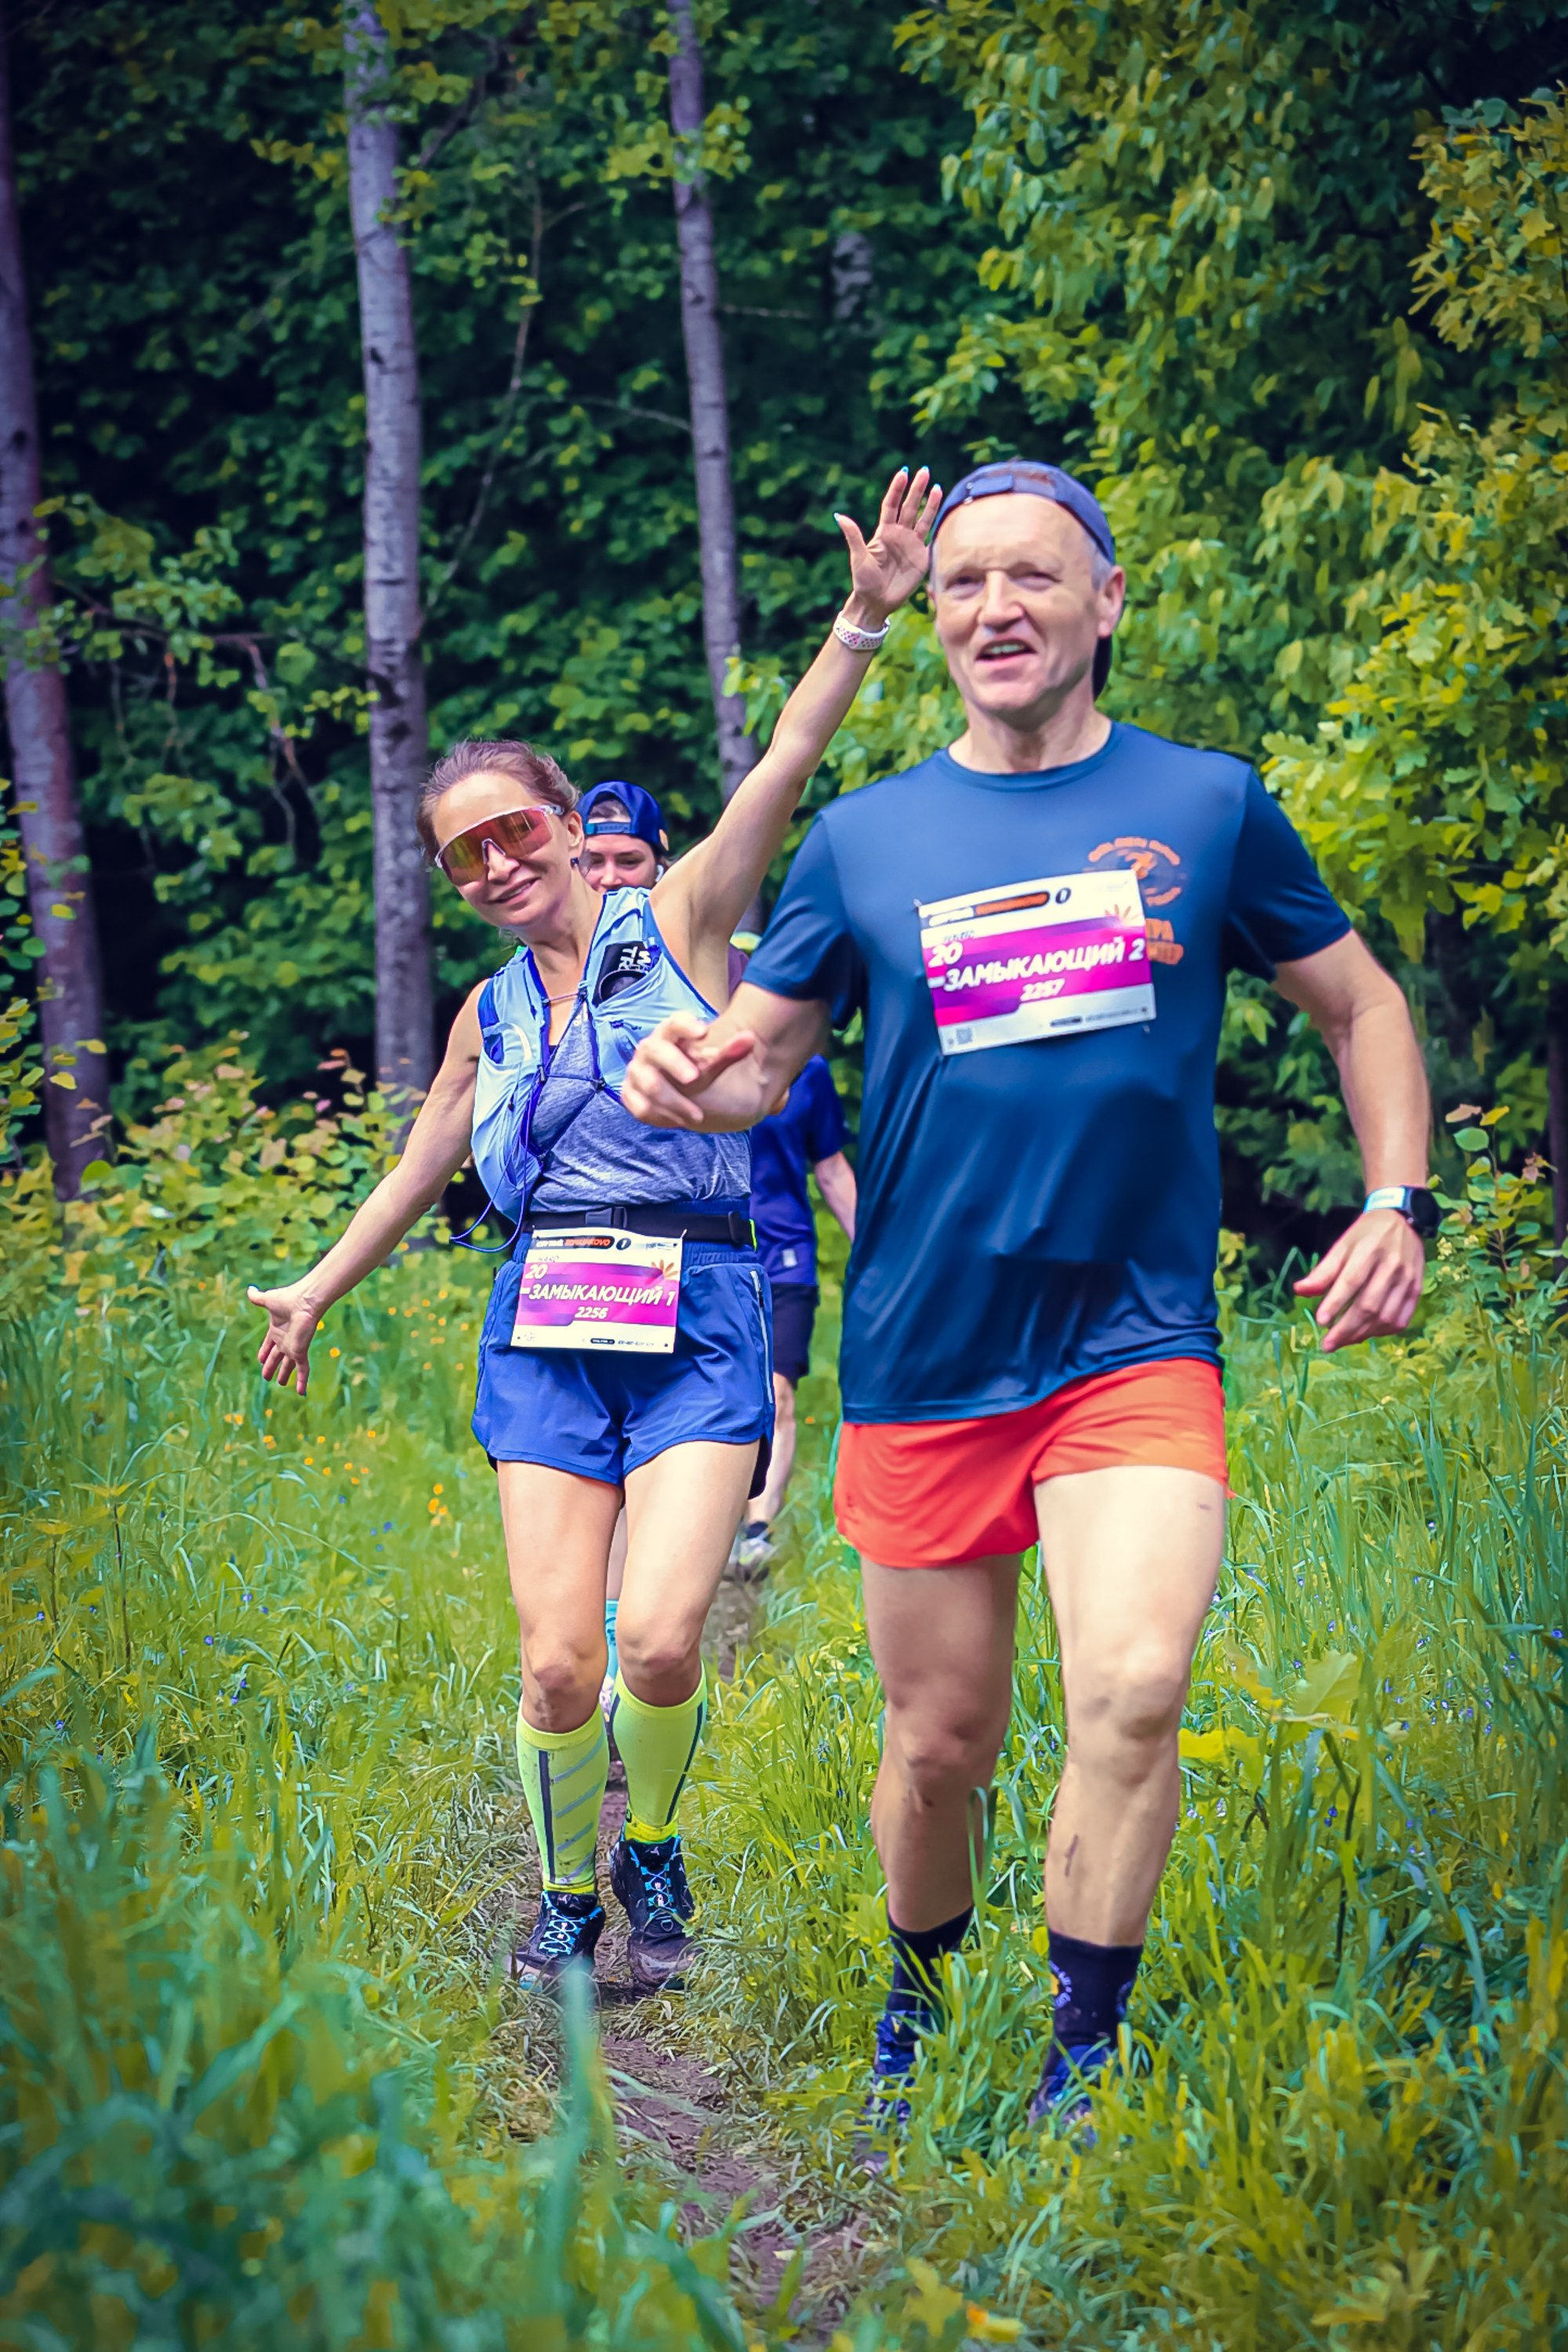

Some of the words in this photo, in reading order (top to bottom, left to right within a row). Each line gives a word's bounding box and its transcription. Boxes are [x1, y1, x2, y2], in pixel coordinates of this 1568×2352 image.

[927, 941, 964, 967] 20
[944, 936, 1126, 991] ЗАМЫКАЮЩИЙ
[1128, 938, 1145, 960] 2
[525, 1264, 548, 1279] 20
[528, 1283, 663, 1305] ЗАМЫКАЮЩИЙ
[666, 1291, 676, 1306] 1
[575, 1306, 608, 1319] 2256
